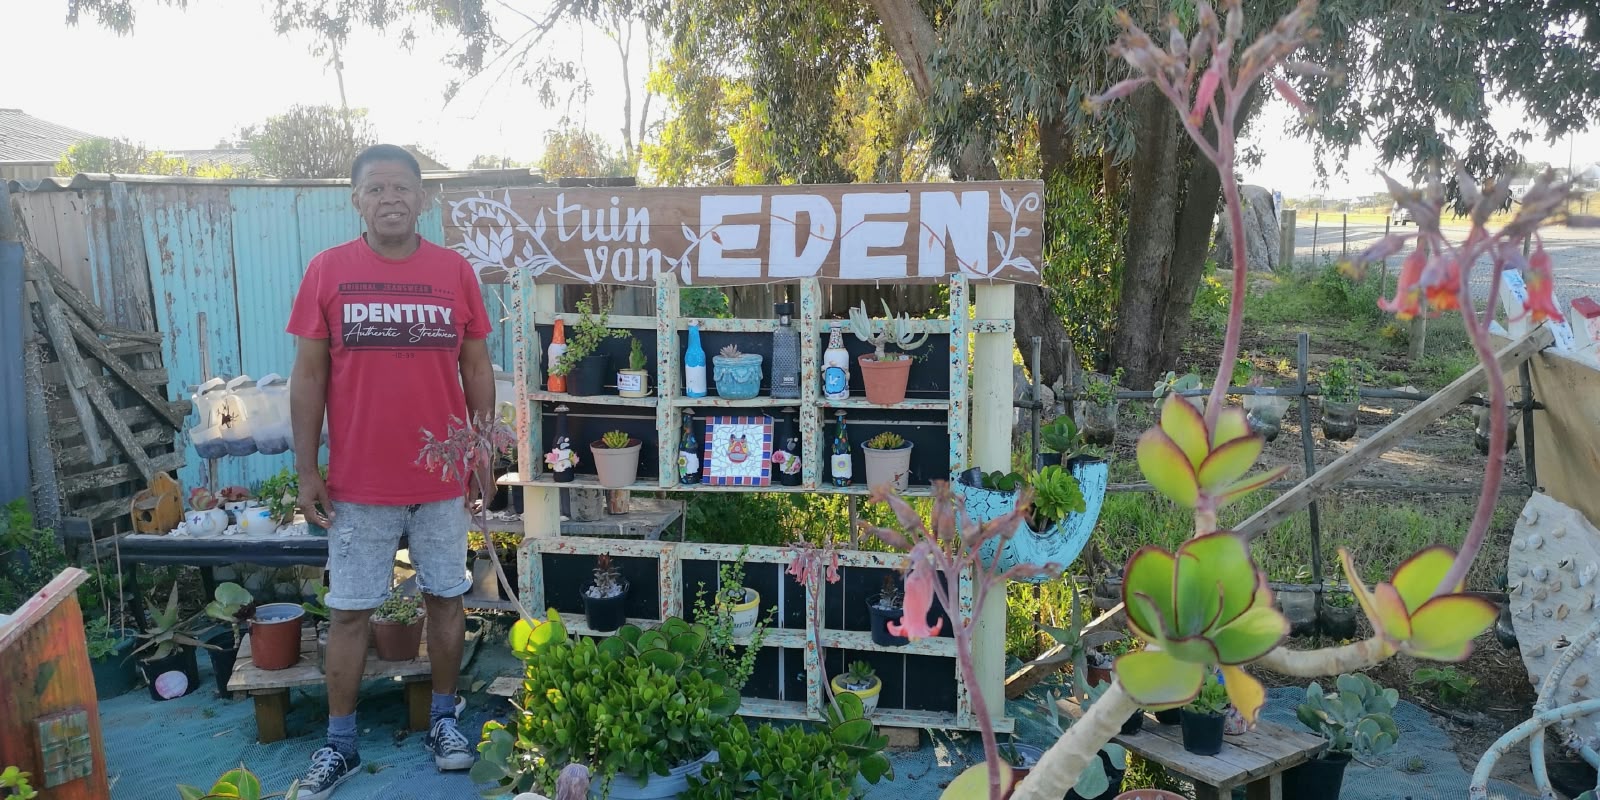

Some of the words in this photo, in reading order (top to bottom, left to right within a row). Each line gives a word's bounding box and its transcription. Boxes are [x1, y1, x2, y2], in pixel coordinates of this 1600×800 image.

[548, 192, 651, 245] tuin
[698, 191, 990, 279] EDEN
[584, 246, 662, 284] van
[343, 303, 452, 325] IDENTITY
[344, 322, 401, 342] Authentic
[408, 322, 457, 343] Streetwear
